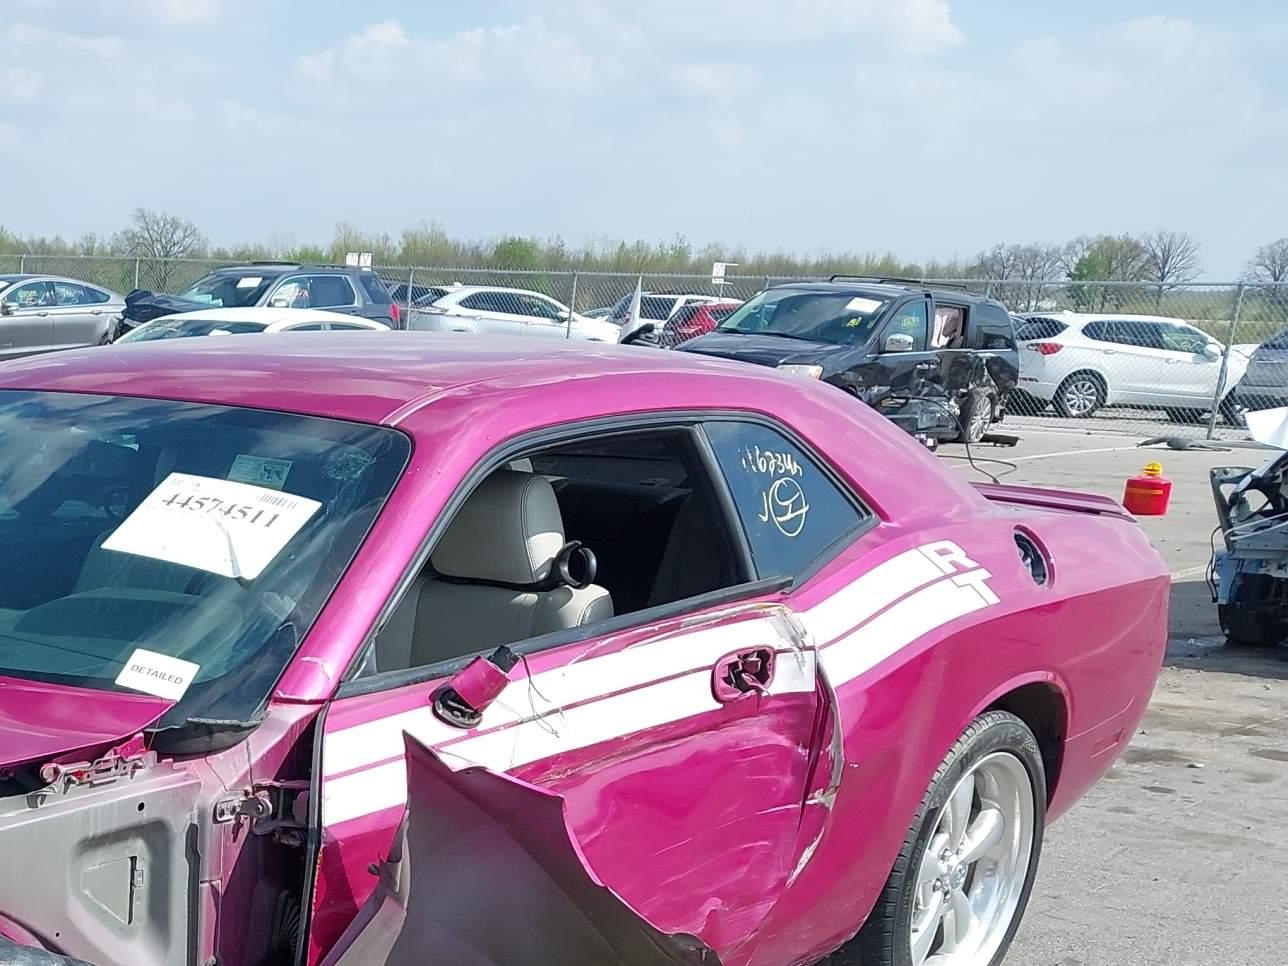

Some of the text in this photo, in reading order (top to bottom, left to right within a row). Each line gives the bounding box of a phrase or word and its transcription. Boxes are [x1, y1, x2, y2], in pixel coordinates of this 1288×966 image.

[162, 492, 280, 528] 44574511
[917, 539, 981, 575] R
[950, 566, 1001, 606] T
[130, 664, 184, 685] DETAILED
